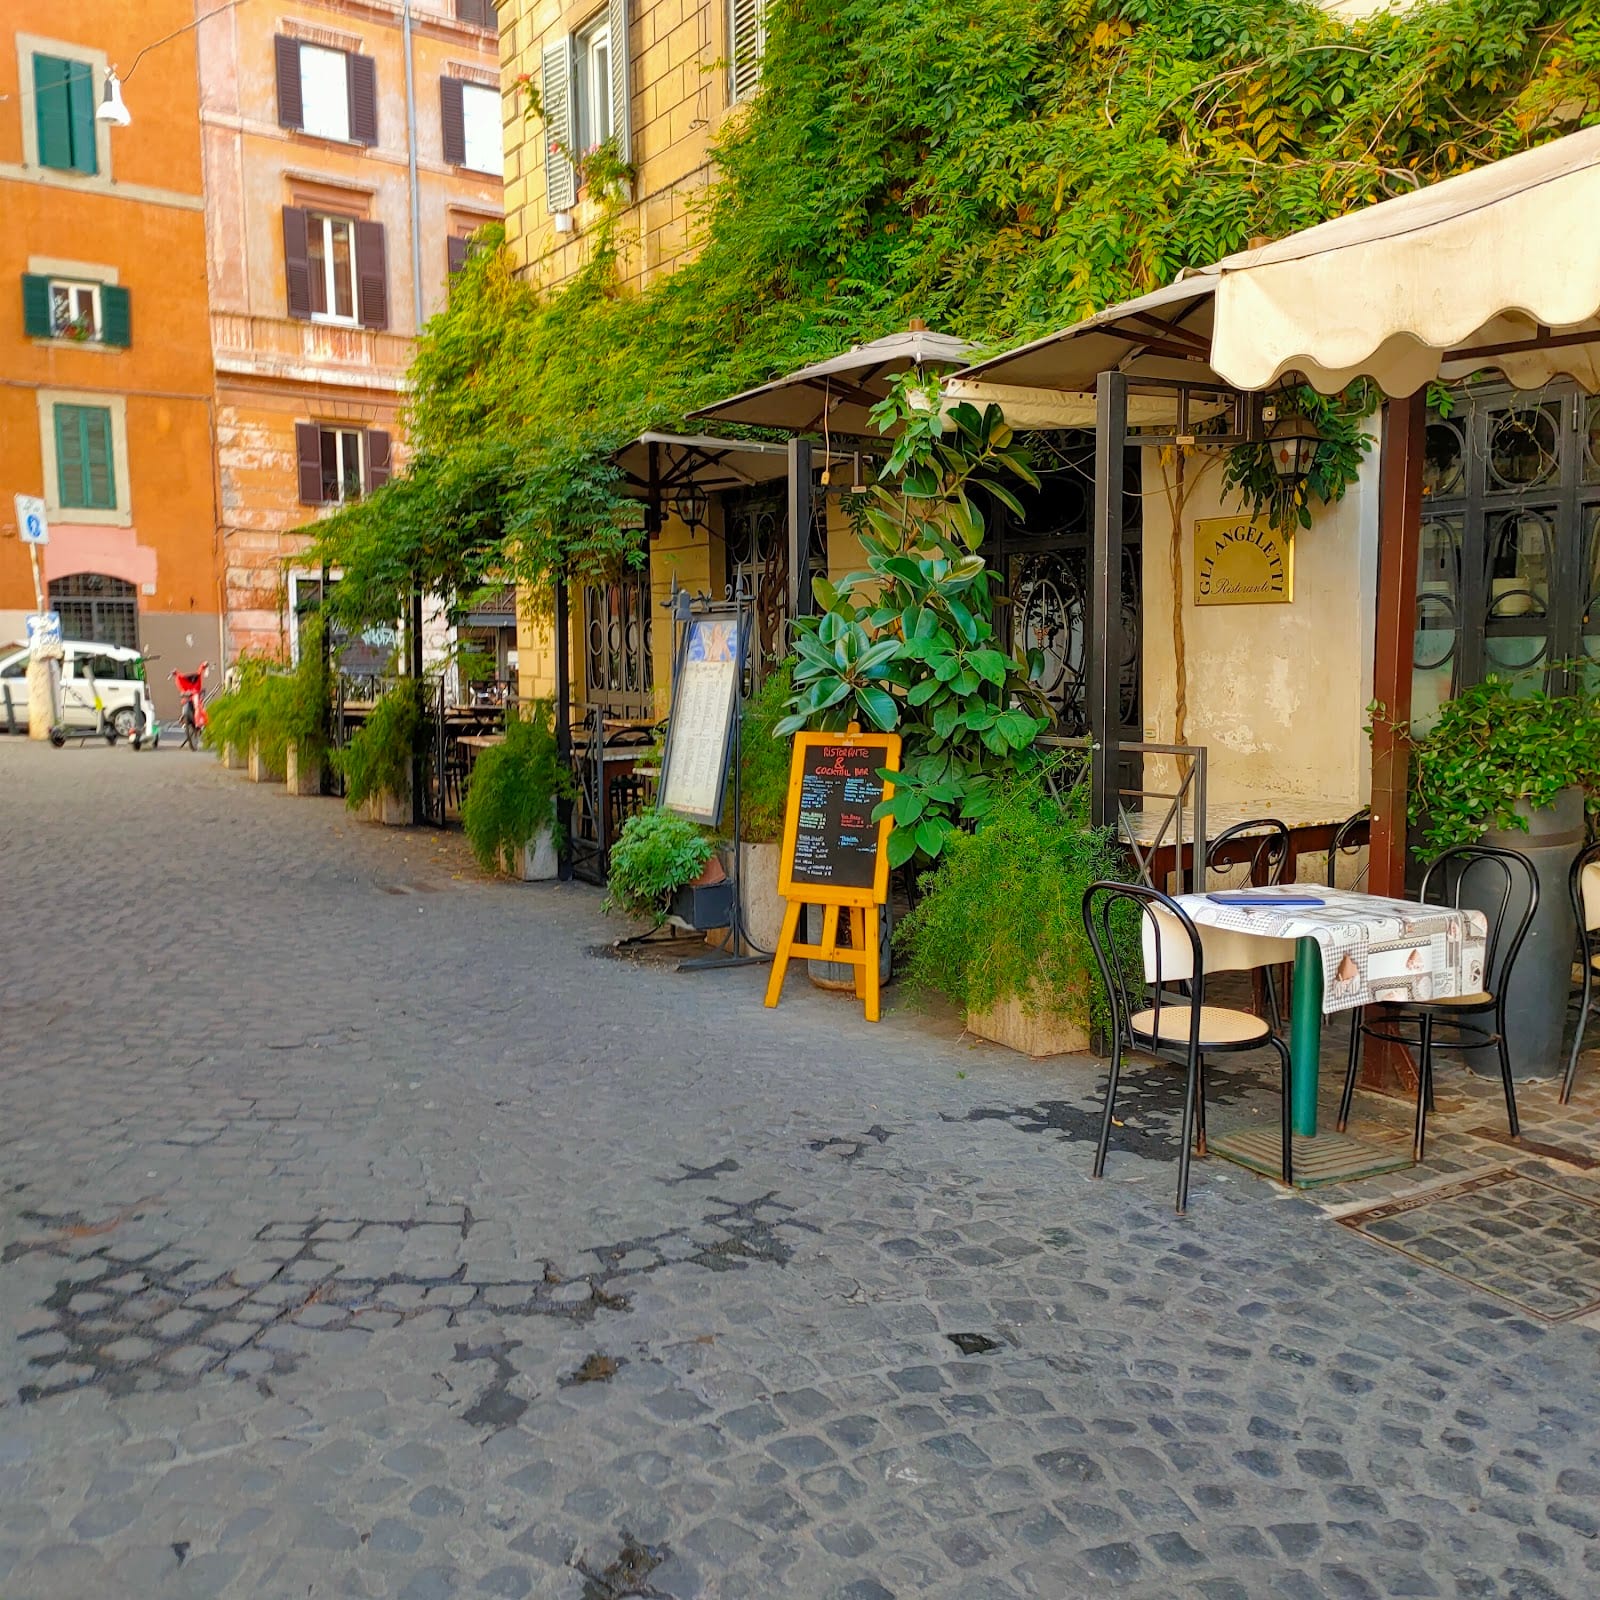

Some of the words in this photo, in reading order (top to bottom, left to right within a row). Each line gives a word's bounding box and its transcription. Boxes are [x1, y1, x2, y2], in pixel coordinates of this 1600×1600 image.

[1199, 556, 1214, 595] GLI
[1214, 525, 1284, 592] ANGELETTI
[1211, 577, 1270, 594] Ristorante
[834, 757, 845, 769] &
[815, 766, 851, 777] COCKTAIL
[854, 767, 869, 776] BAR
